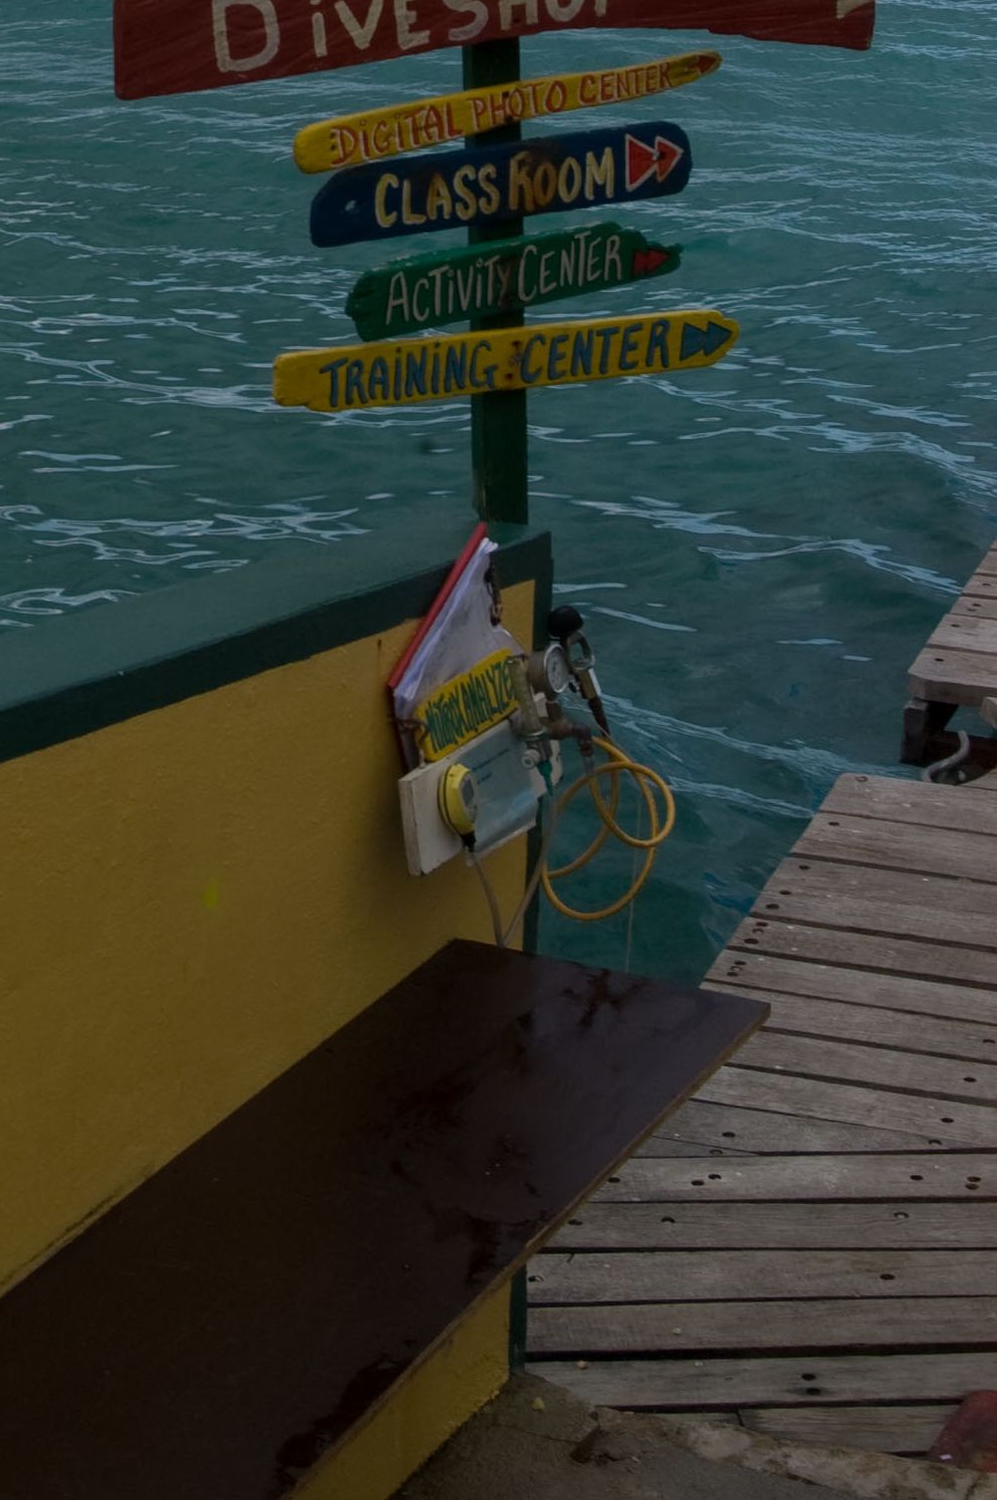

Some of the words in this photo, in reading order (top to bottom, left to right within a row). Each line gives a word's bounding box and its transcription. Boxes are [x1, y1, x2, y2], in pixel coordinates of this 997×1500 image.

[472, 79, 567, 129] PHOTO
[578, 62, 675, 106] CENTER
[517, 232, 624, 302] CENTER
[520, 320, 671, 383] CENTER
